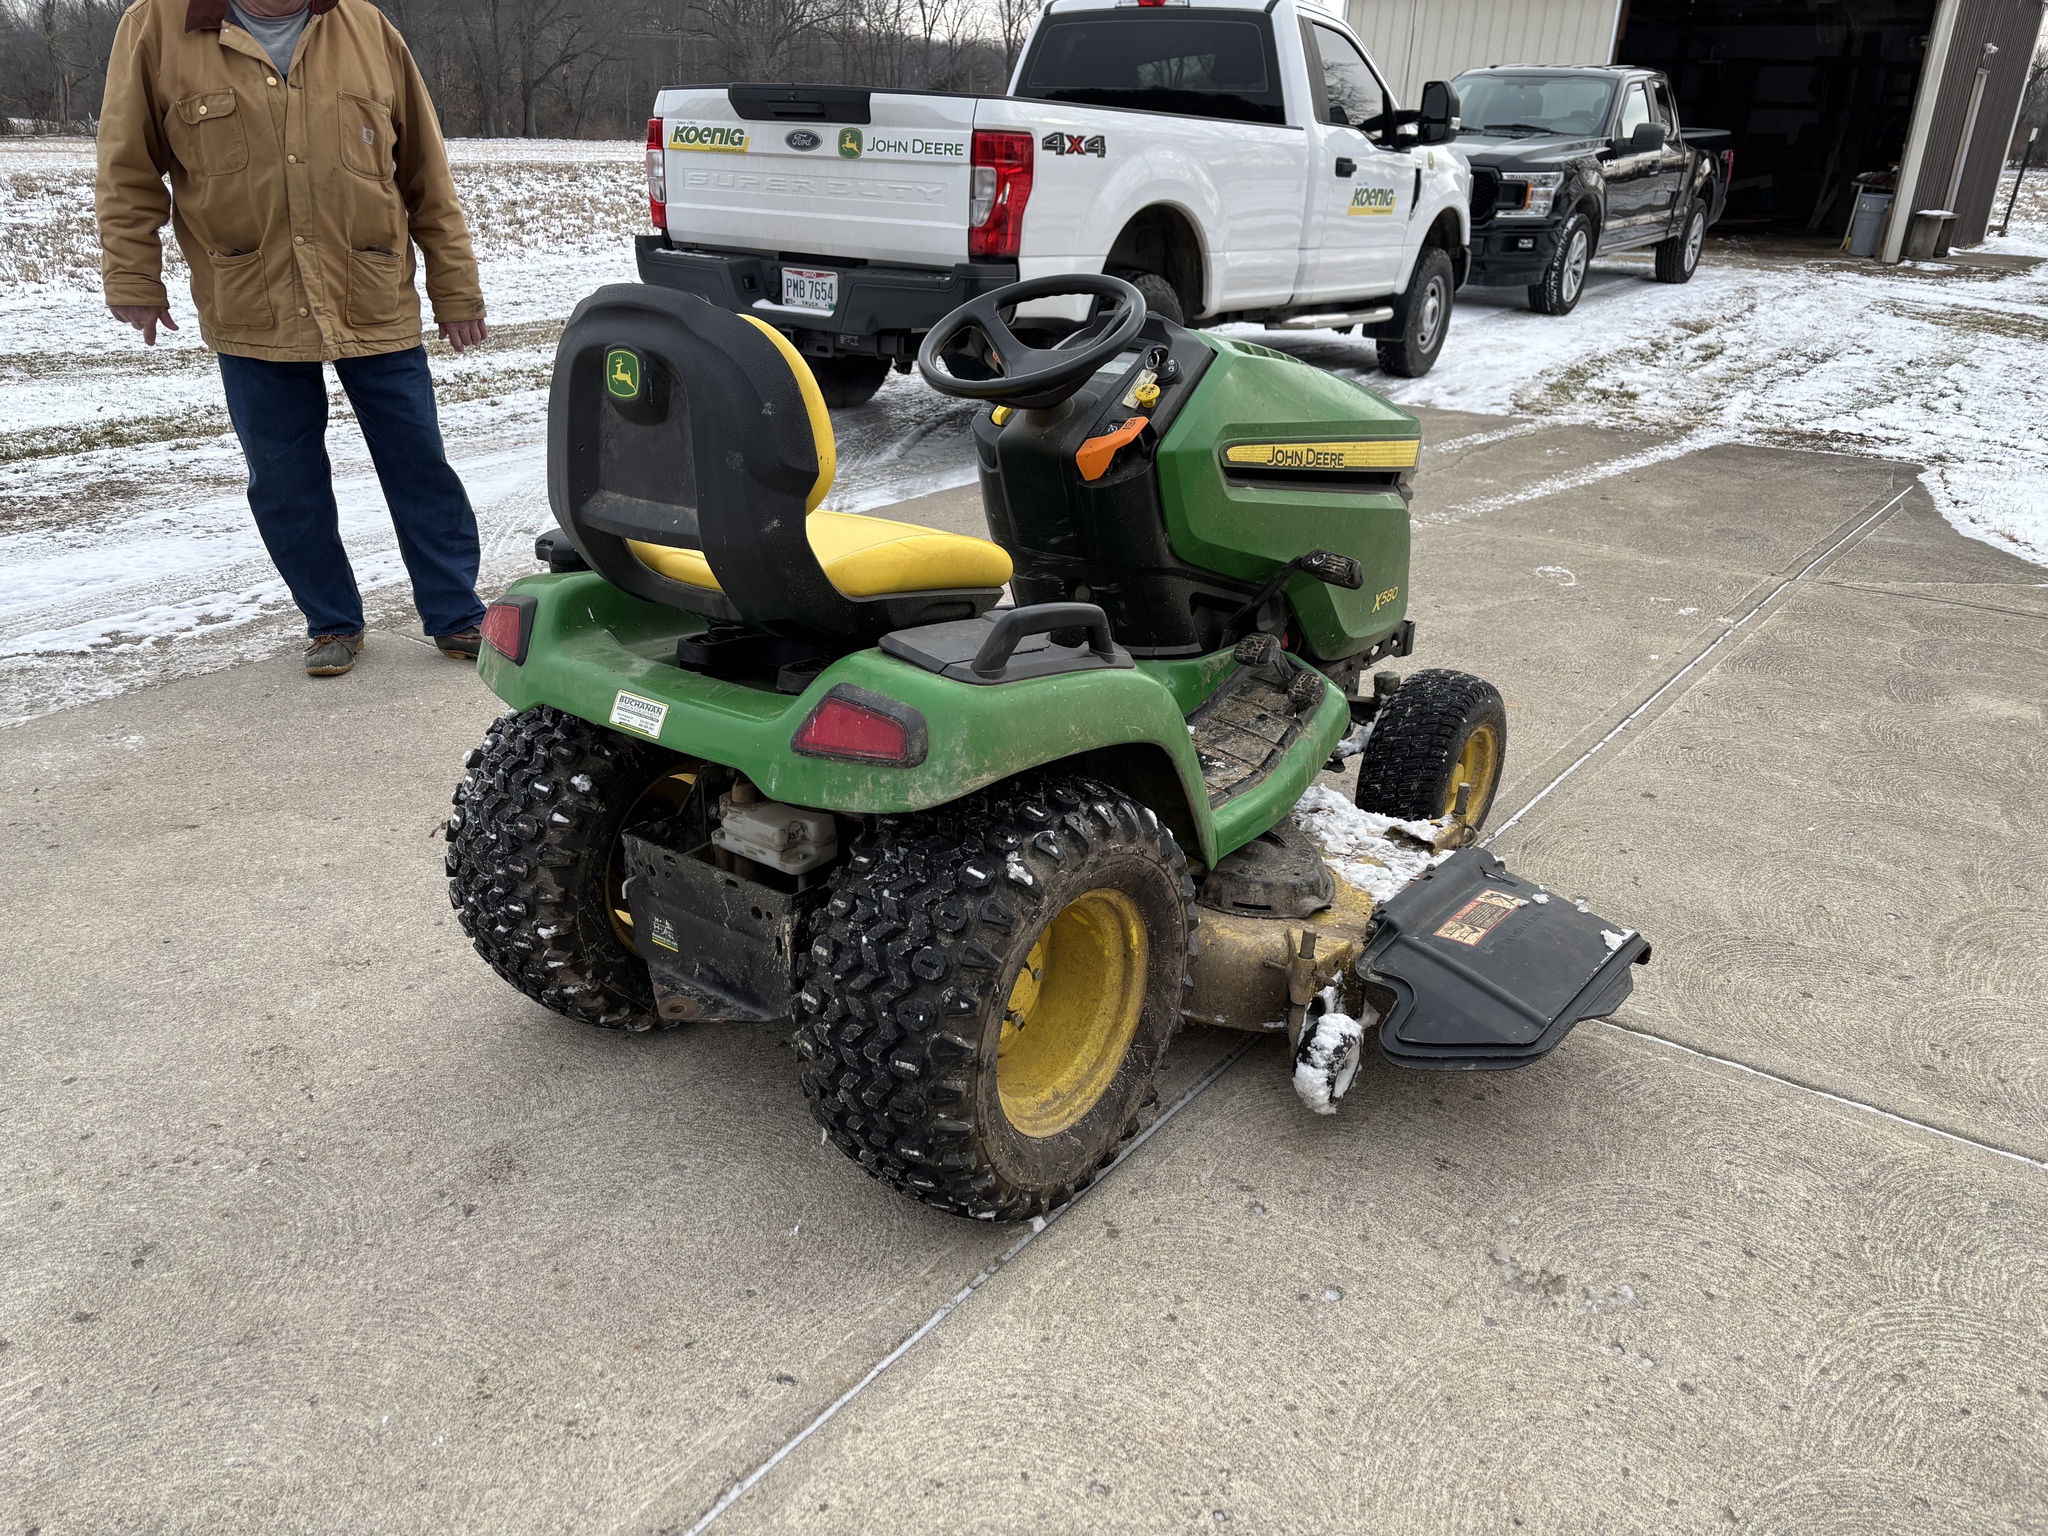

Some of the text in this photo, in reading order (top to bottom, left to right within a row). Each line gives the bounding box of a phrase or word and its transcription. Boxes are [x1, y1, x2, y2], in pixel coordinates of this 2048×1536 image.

[791, 133, 813, 146] Ford
[866, 136, 965, 156] JOHN DEERE
[687, 172, 942, 201] SUPER DUTY
[786, 278, 833, 302] PMB 7654
[1267, 446, 1345, 467] JOHN DEERE
[1371, 585, 1399, 613] X580
[619, 695, 663, 715] BUCHANAN
